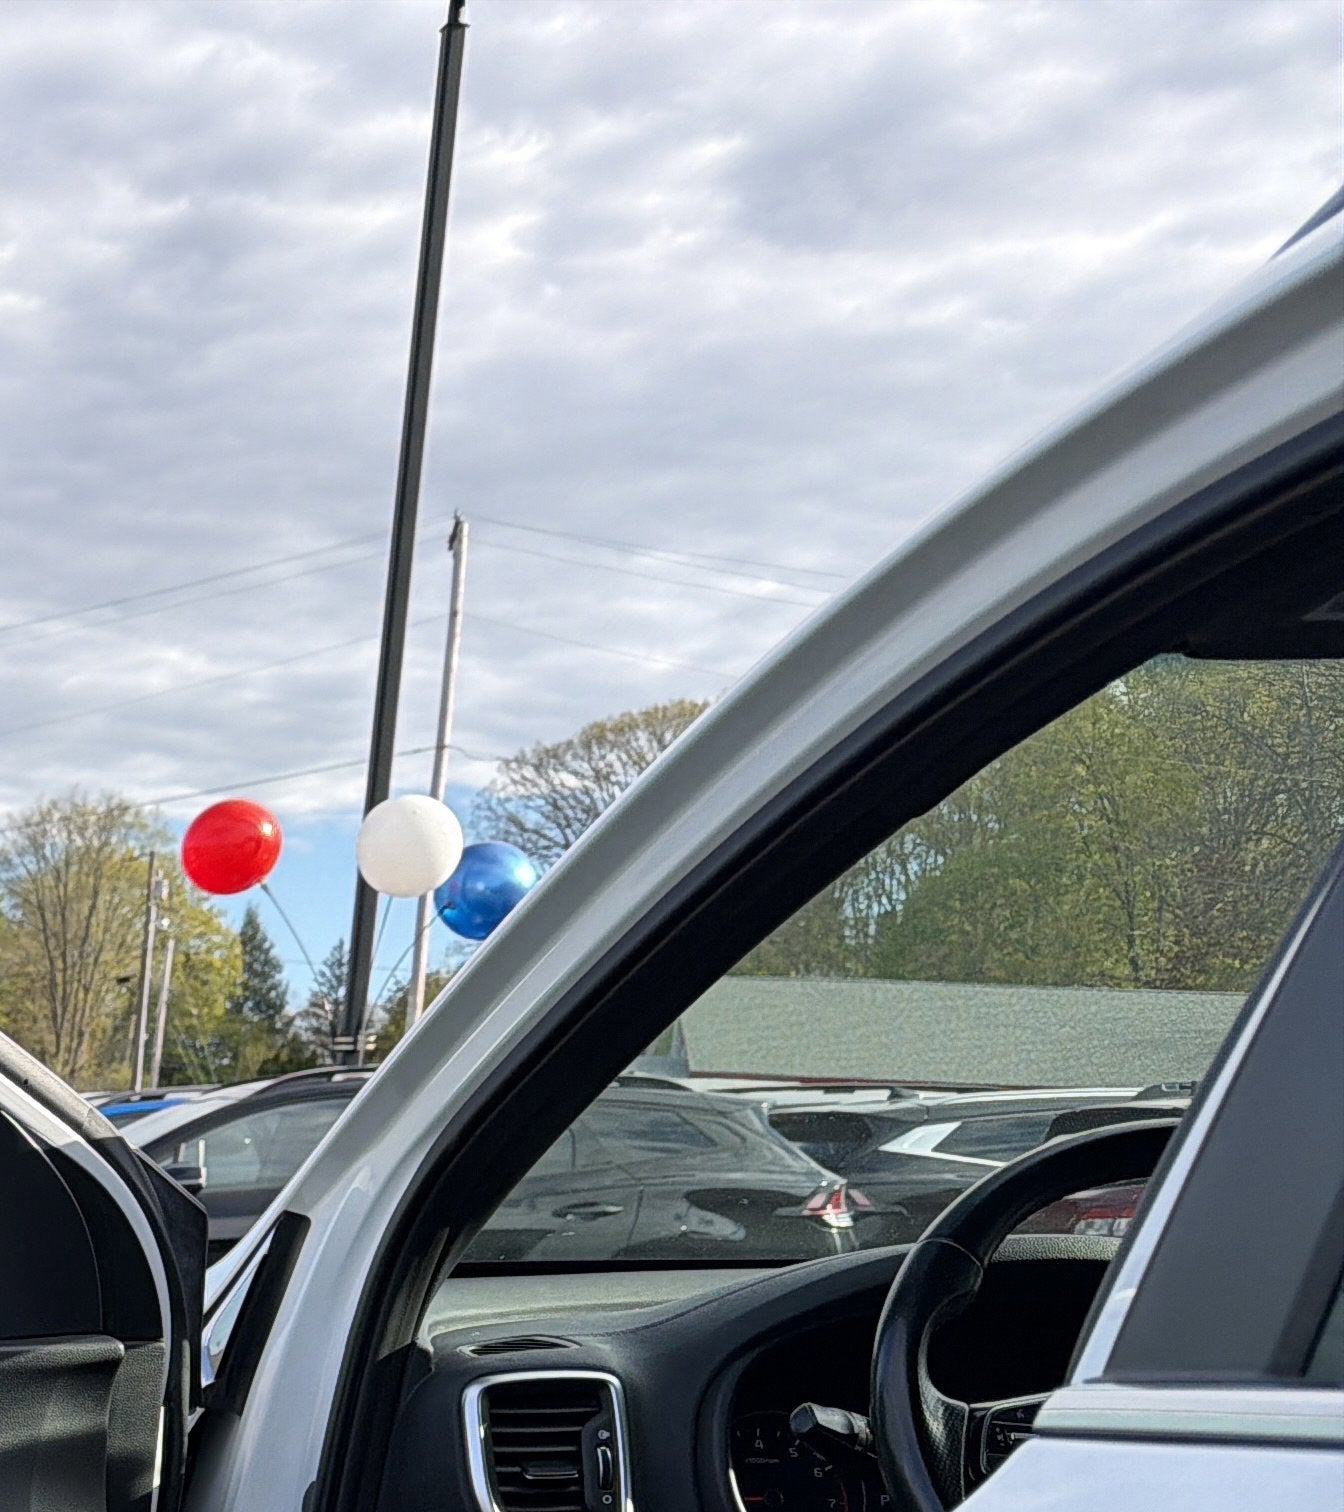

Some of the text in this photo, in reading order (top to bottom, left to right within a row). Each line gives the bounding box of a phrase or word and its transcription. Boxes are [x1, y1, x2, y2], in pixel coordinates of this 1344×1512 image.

[788, 1447, 799, 1459] 5
[813, 1467, 823, 1478] 6
[828, 1498, 837, 1509] 7
